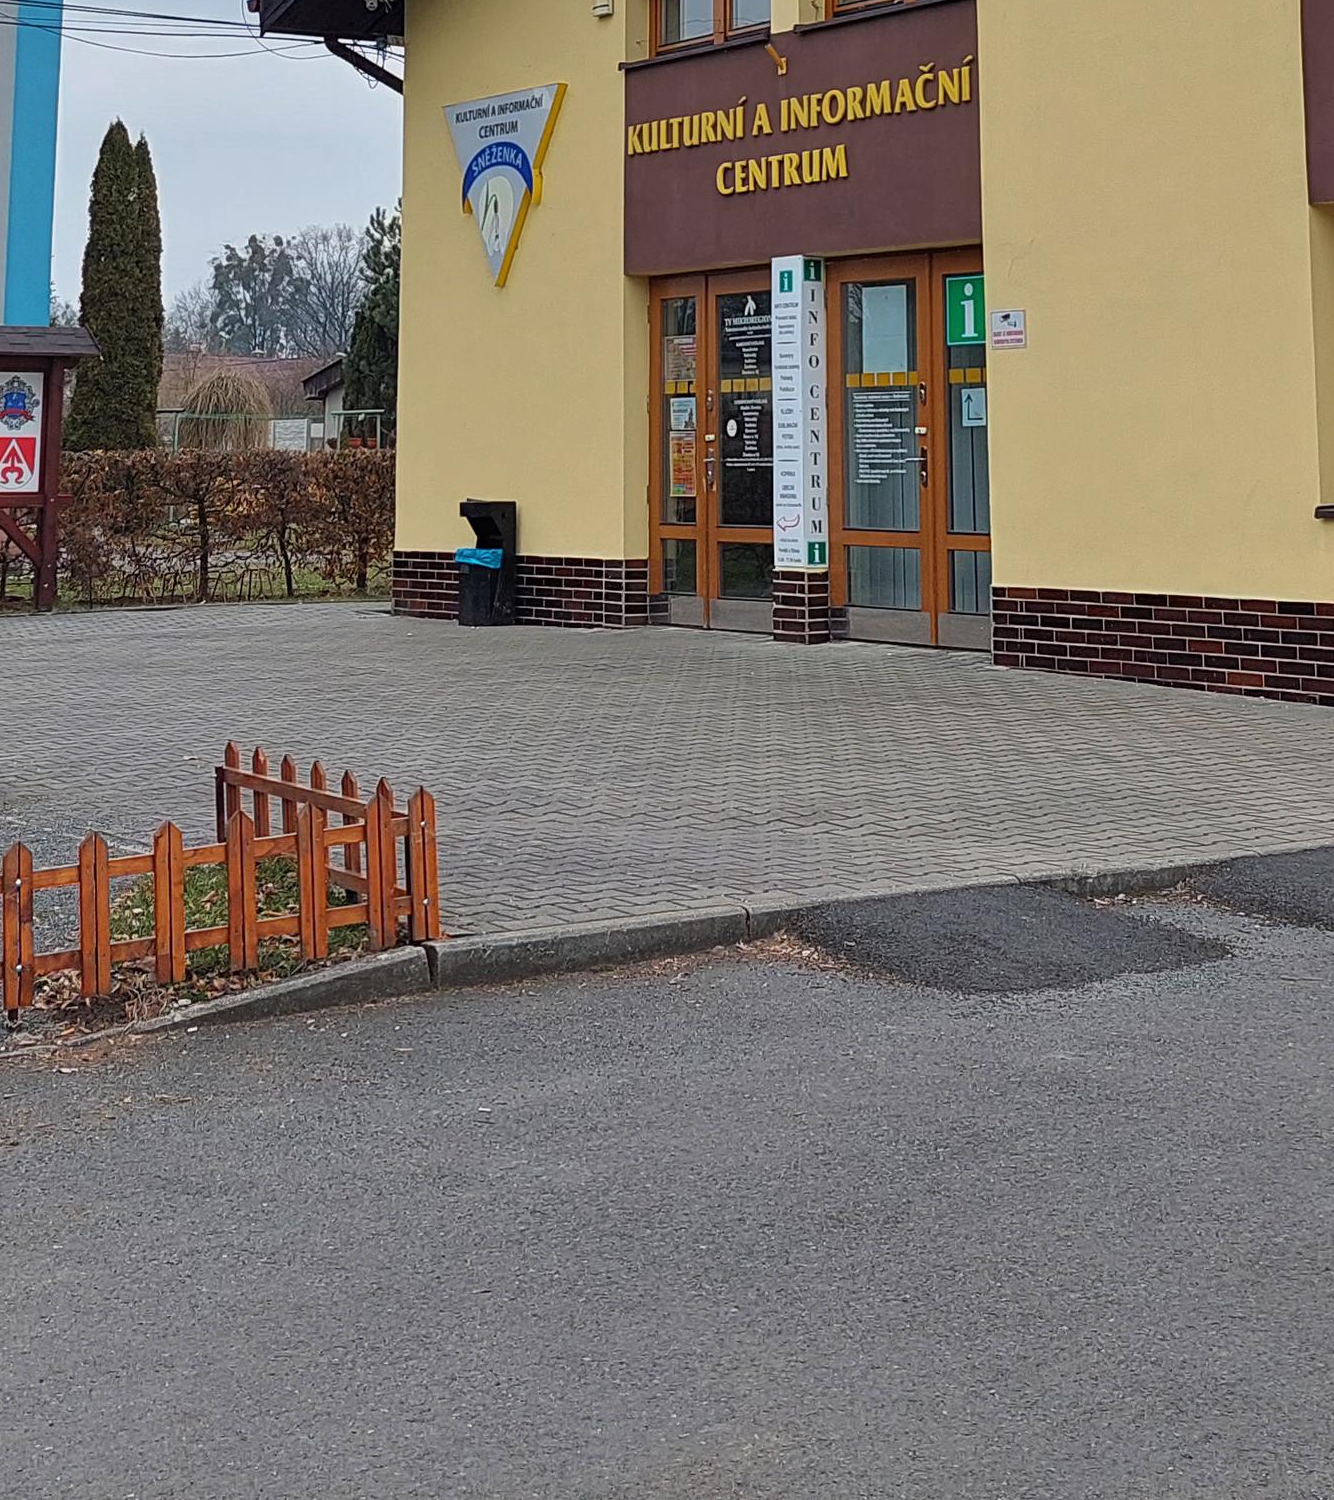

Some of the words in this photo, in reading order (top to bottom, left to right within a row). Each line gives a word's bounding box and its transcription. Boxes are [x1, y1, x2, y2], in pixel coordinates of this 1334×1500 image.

[455, 103, 491, 125] KULTURNÍ
[497, 93, 544, 116] INFORMAČNÍ
[627, 96, 747, 156] KULTURNÍ
[752, 103, 773, 137] A
[780, 54, 974, 133] INFORMAČNÍ
[478, 120, 519, 139] CENTRUM
[471, 145, 523, 177] SNĚŽENKA
[716, 143, 849, 196] CENTRUM
